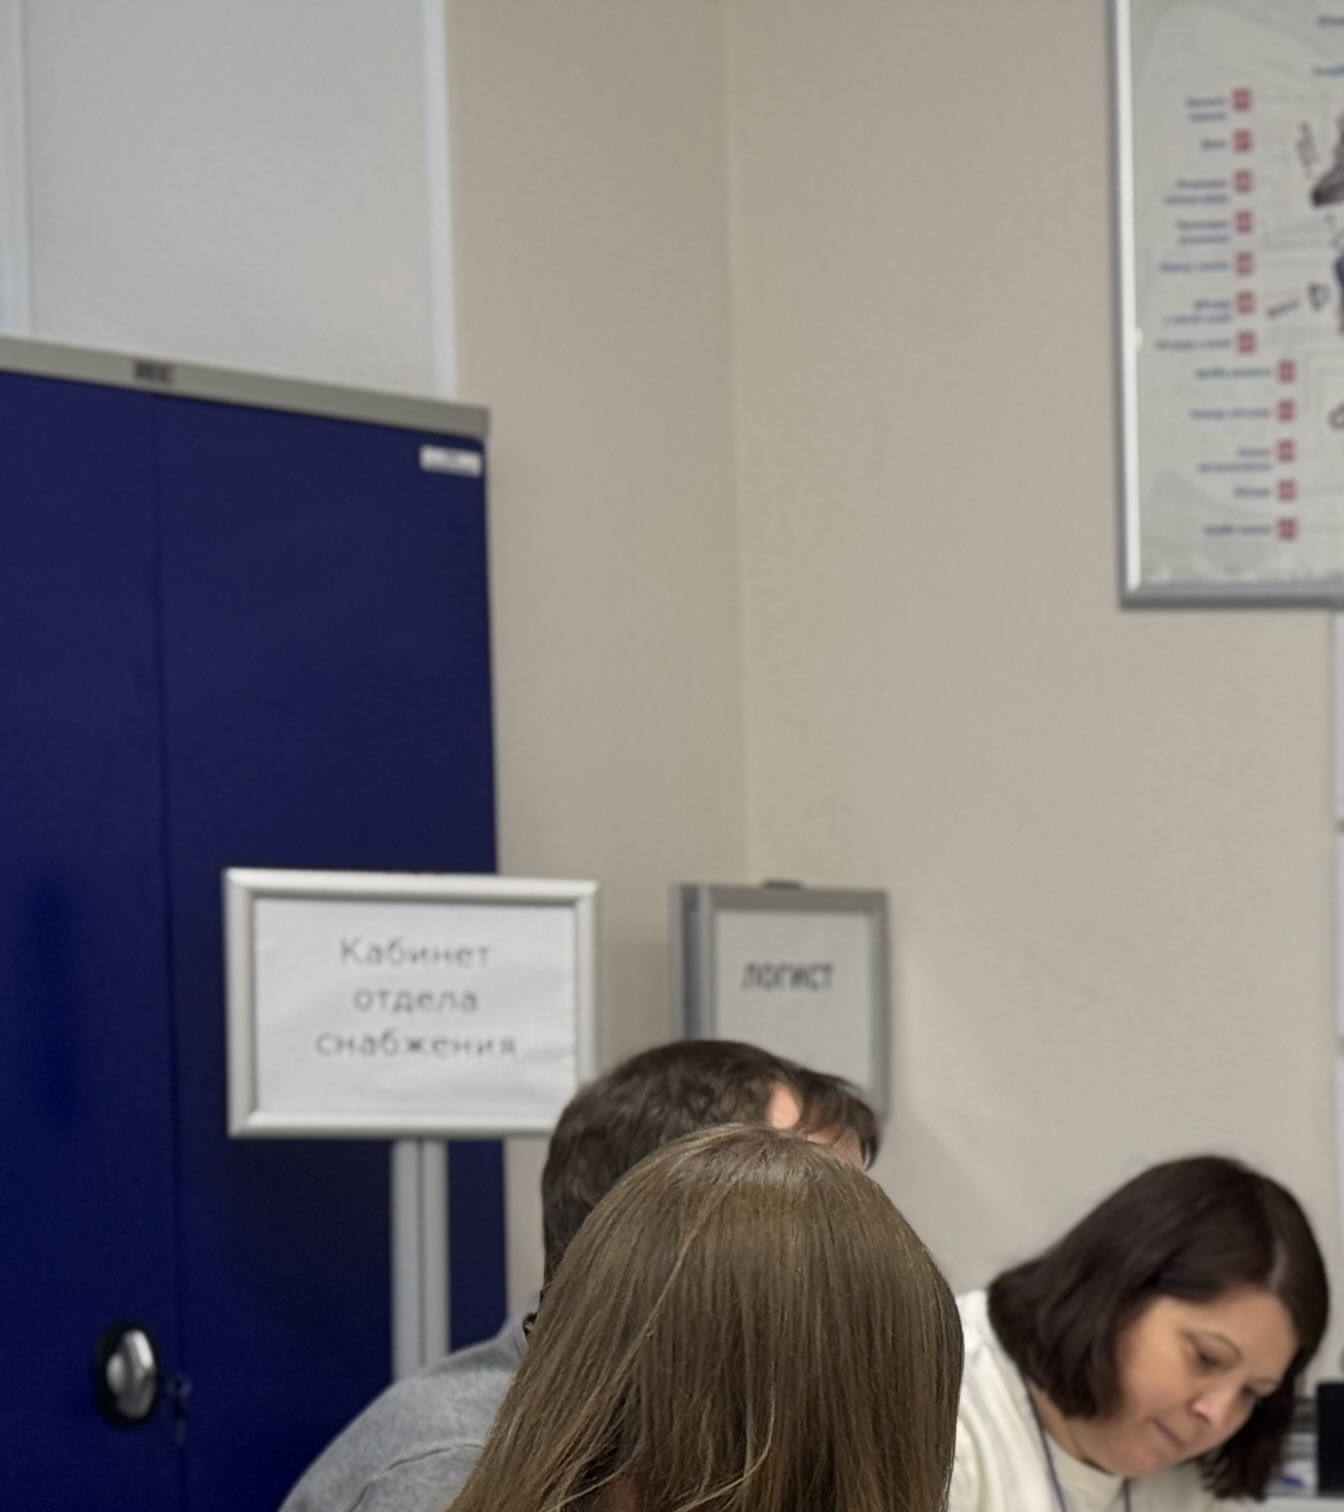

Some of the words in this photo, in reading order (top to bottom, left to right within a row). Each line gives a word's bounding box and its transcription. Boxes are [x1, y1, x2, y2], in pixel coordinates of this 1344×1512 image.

[340, 934, 491, 967] Кабинет
[740, 961, 834, 992] ЛОГИСТ
[352, 987, 478, 1014] отдела
[314, 1027, 517, 1058] снабжения
